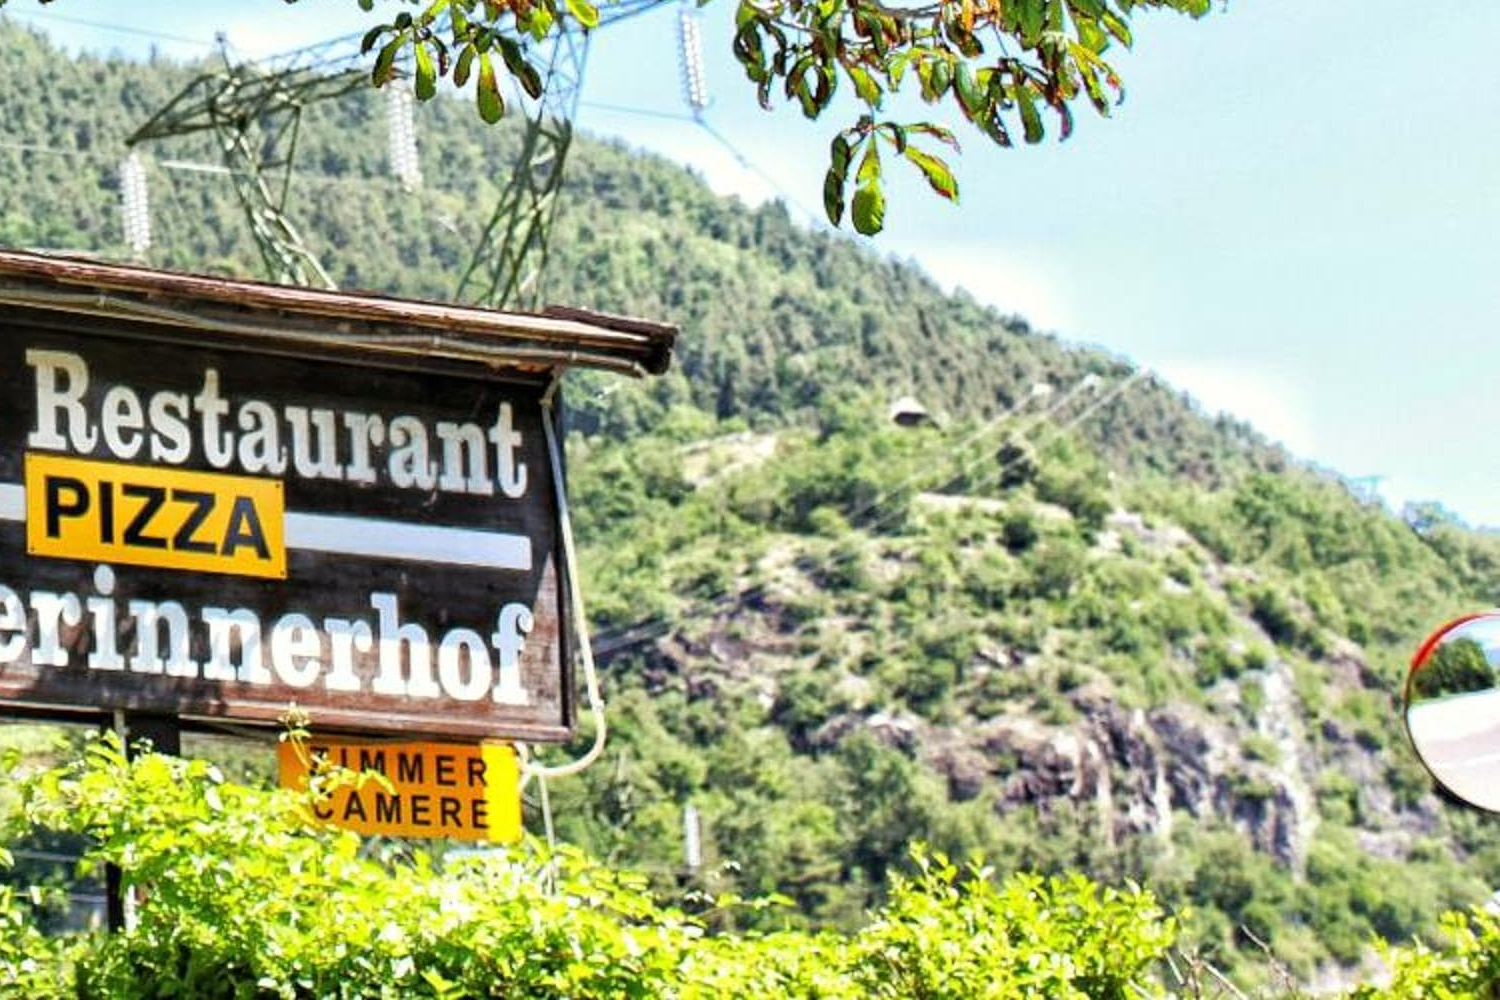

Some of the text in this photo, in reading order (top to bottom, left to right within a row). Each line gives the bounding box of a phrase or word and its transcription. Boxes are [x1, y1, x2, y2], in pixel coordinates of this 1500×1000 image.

[25, 349, 528, 499] Restaurant
[45, 475, 273, 561] PIZZA
[313, 788, 490, 829] CAMERE
